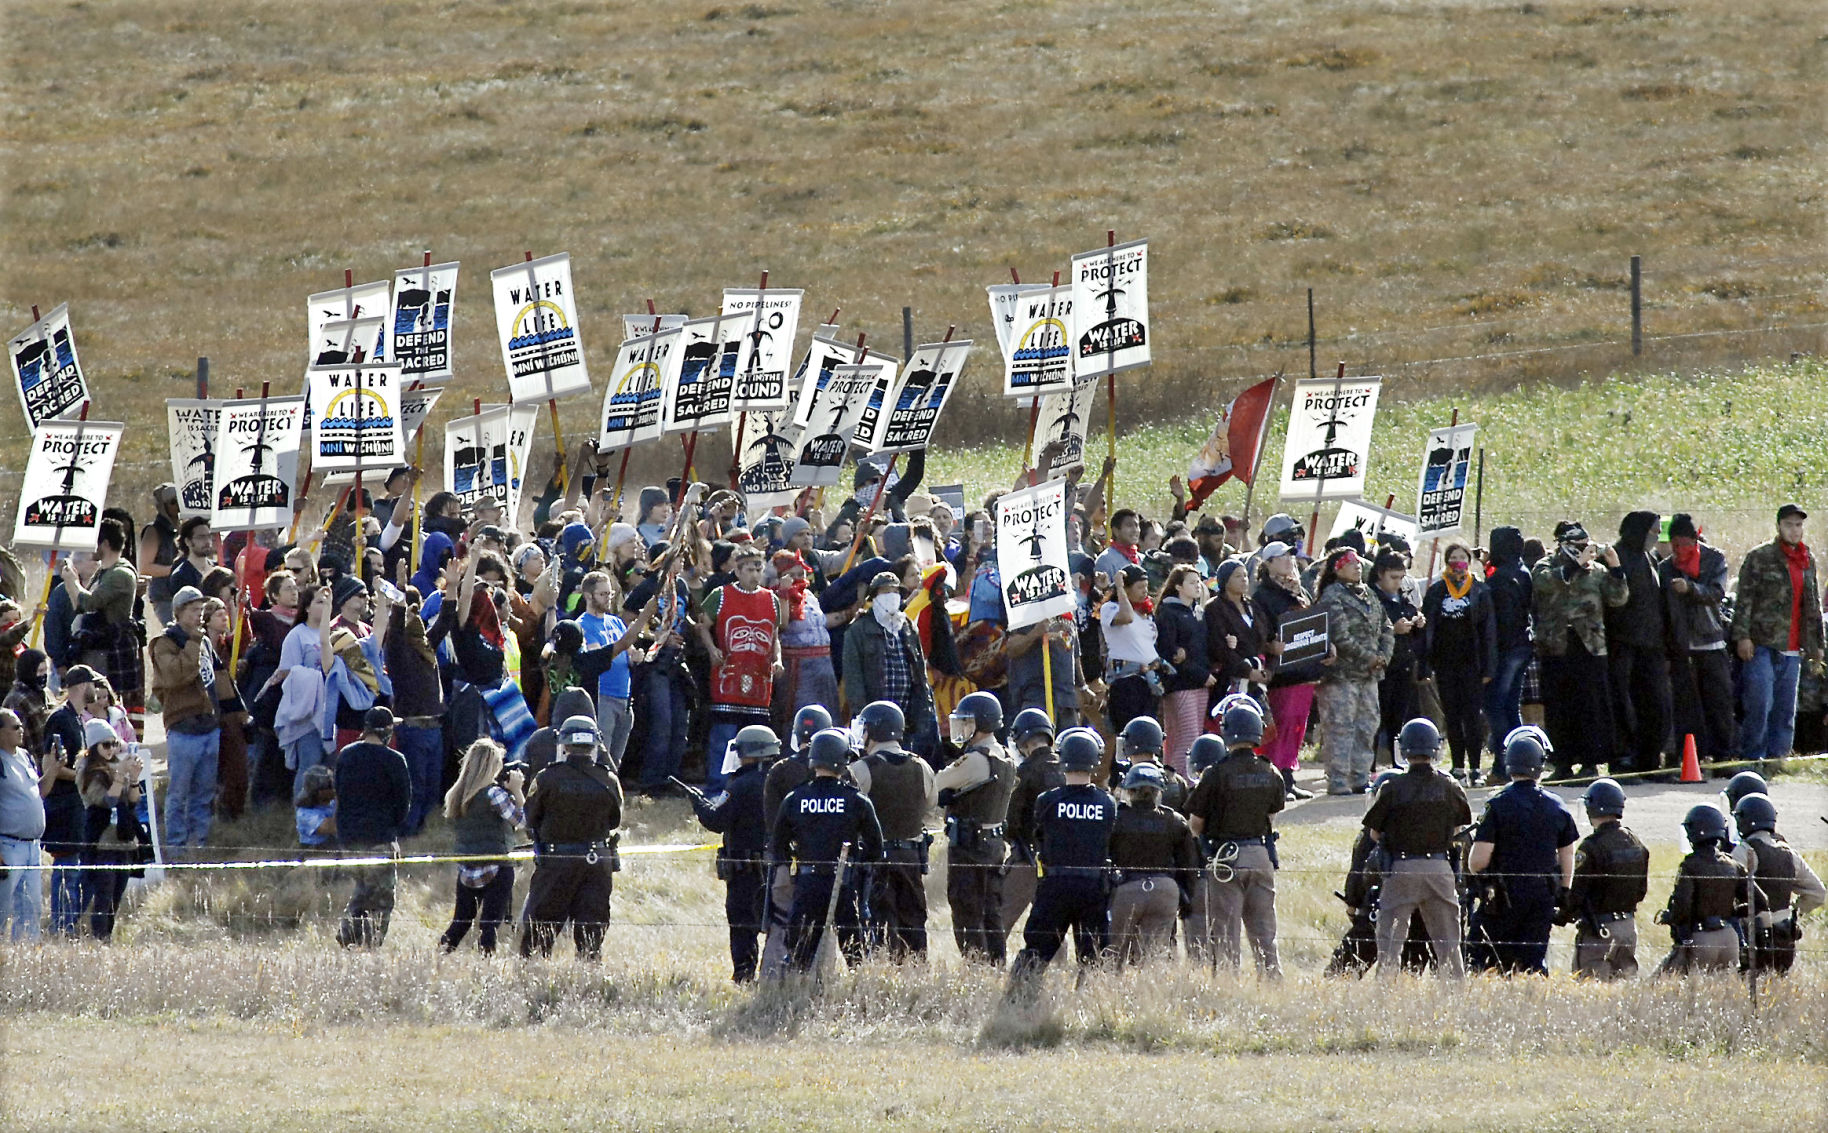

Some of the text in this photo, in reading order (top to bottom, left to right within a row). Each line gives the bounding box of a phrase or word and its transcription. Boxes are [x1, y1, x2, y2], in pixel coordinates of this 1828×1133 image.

[1081, 258, 1142, 282] PROTECT
[510, 280, 562, 305] WATER
[730, 301, 744, 309] NO
[1028, 300, 1072, 318] WATER
[524, 313, 555, 334] LIFE
[396, 331, 446, 348] DEFEND
[1030, 331, 1058, 347] LIFE
[1088, 320, 1138, 344] WATER
[1099, 340, 1108, 348] IS
[396, 354, 445, 370] SACRED
[628, 344, 670, 364] WATER
[27, 365, 74, 402] DEFEND
[329, 372, 387, 387] WATER
[764, 373, 781, 381] THE
[679, 378, 731, 396] DEFEND
[736, 382, 780, 398] OUND
[829, 381, 872, 394] PROTECT
[33, 384, 80, 422] SACRED
[340, 402, 374, 417] LIFE
[677, 398, 728, 416] SACRED
[1305, 395, 1370, 410] PROTECT
[176, 409, 221, 424] WATE
[892, 408, 935, 422] DEFEND
[196, 424, 218, 432] SACRE
[228, 417, 291, 433] PROTECT
[886, 429, 928, 442] SACRED
[42, 440, 110, 456] PROTECT
[810, 439, 844, 454] WATER
[1304, 452, 1356, 469] WATER
[230, 480, 282, 496] WATER
[746, 484, 760, 493] NO
[1423, 488, 1462, 505] DEFEND
[38, 500, 92, 515] WATER
[1004, 500, 1061, 527] PROTECT
[1422, 510, 1459, 528] SACRED
[1014, 568, 1062, 592] WATER
[800, 798, 845, 814] POLICE
[1058, 802, 1104, 820] POLICE
